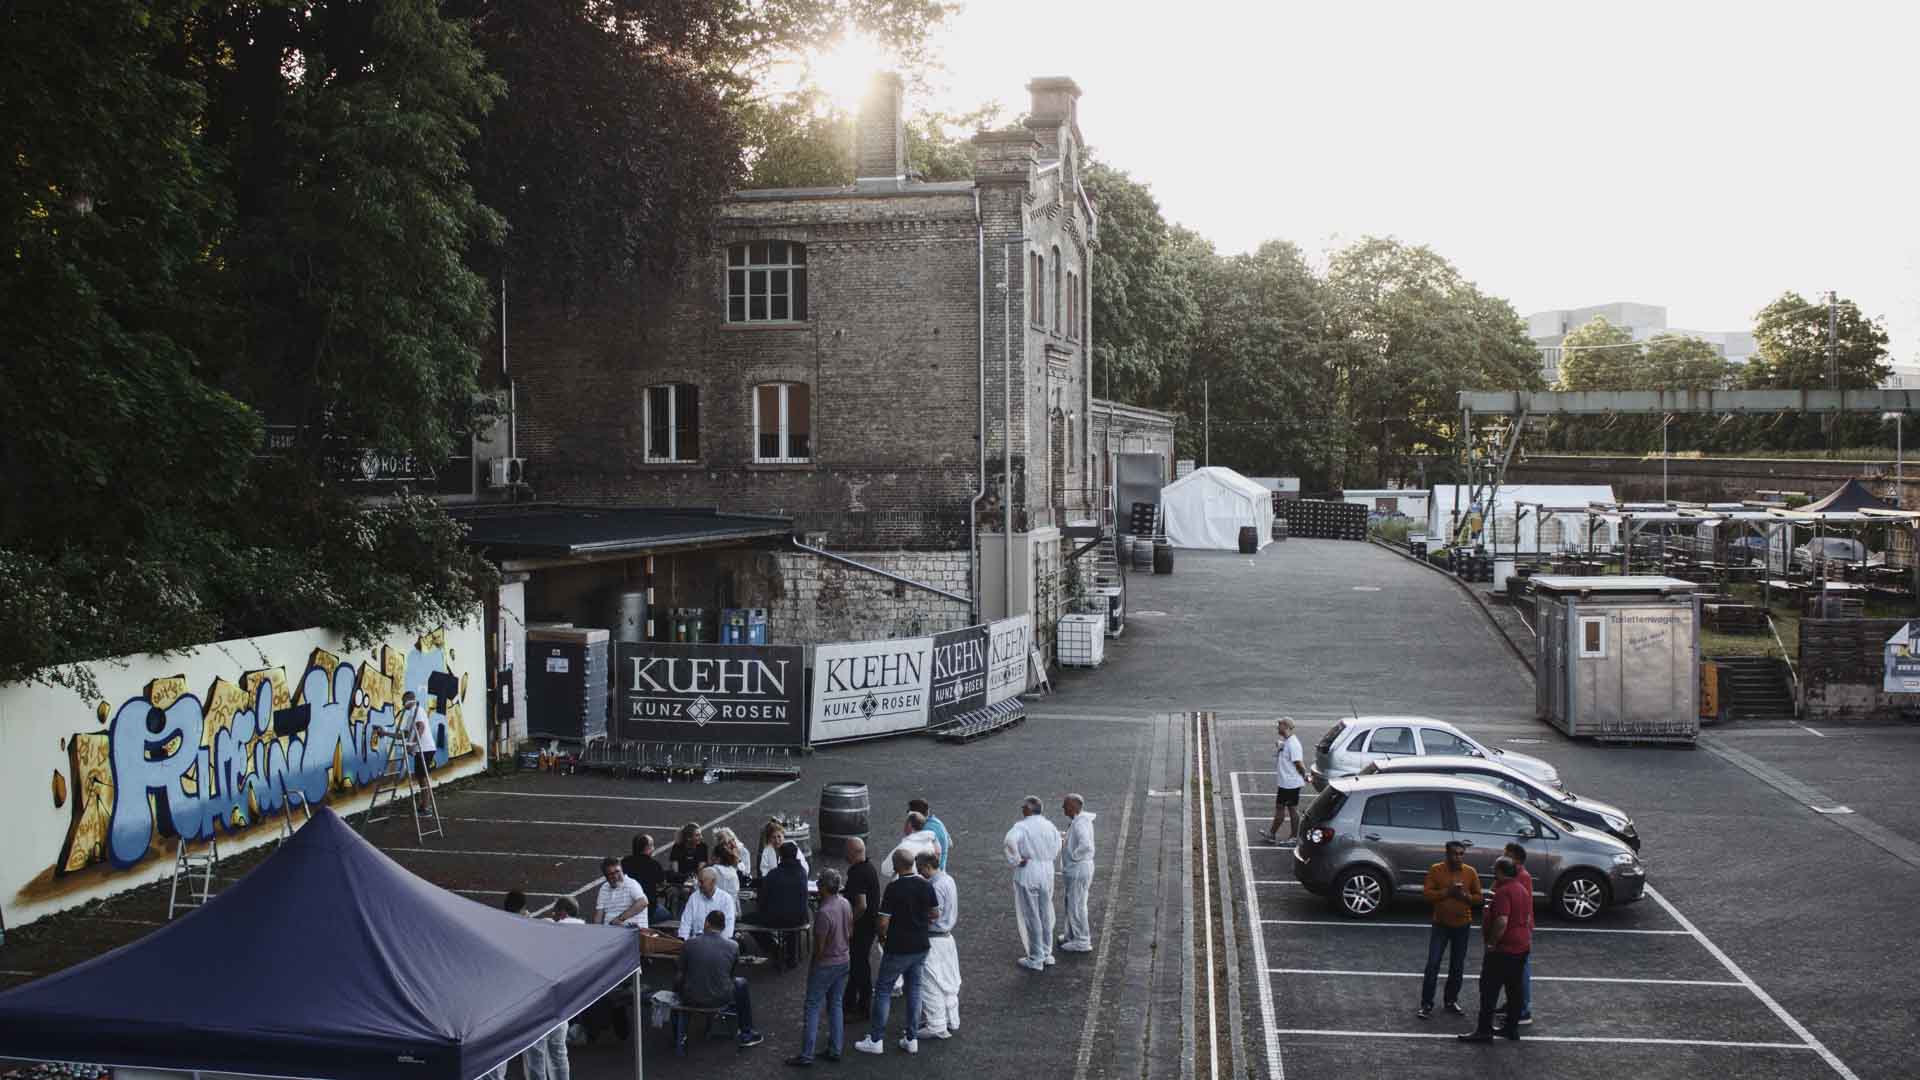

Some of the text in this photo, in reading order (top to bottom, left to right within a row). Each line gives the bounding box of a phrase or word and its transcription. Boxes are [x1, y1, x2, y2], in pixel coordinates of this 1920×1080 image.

[934, 638, 984, 680] KUEHN
[991, 625, 1027, 666] KUEHN
[629, 656, 790, 695] KUEHN
[823, 651, 925, 693] KUEHN
[935, 677, 984, 702] KUNZ ROSEN
[633, 702, 786, 719] KUNZ ROSEN
[824, 694, 921, 717] KUNZ ROSEN
